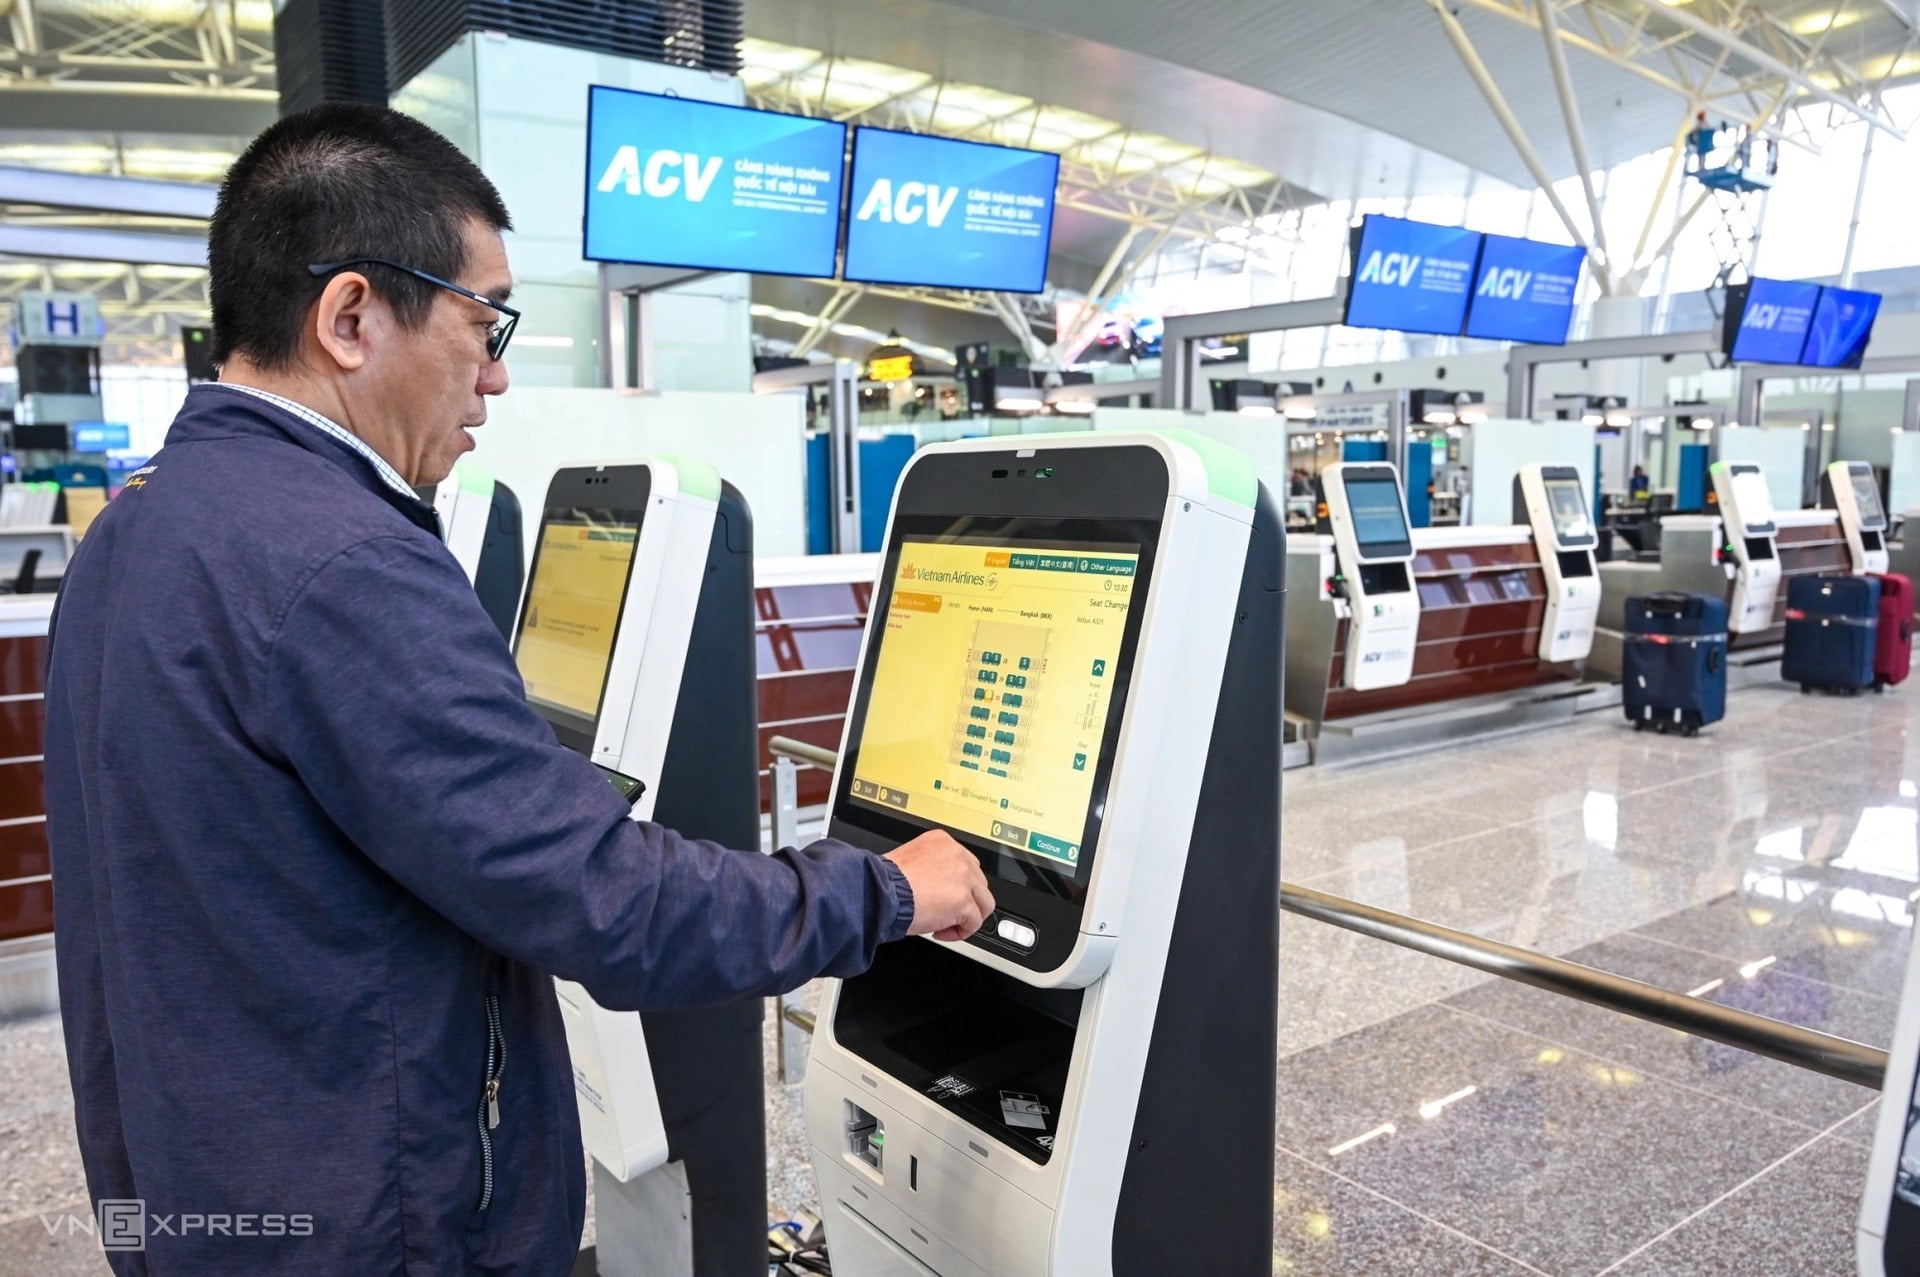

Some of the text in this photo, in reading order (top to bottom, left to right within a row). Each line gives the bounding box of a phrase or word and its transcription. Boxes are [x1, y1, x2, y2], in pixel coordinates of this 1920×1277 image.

[597, 145, 723, 202] ACV
[856, 178, 960, 228] ACV
[1359, 250, 1421, 287] ACV
[1478, 266, 1532, 300] ACV
[46, 302, 78, 335] H
[1743, 302, 1781, 330] ACV
[917, 568, 985, 586] Vietnam Airlines
[1090, 562, 1132, 574] Other Language
[1089, 599, 1128, 611] Seat Change
[1007, 830, 1019, 840] Back
[1036, 839, 1061, 854] Continue
